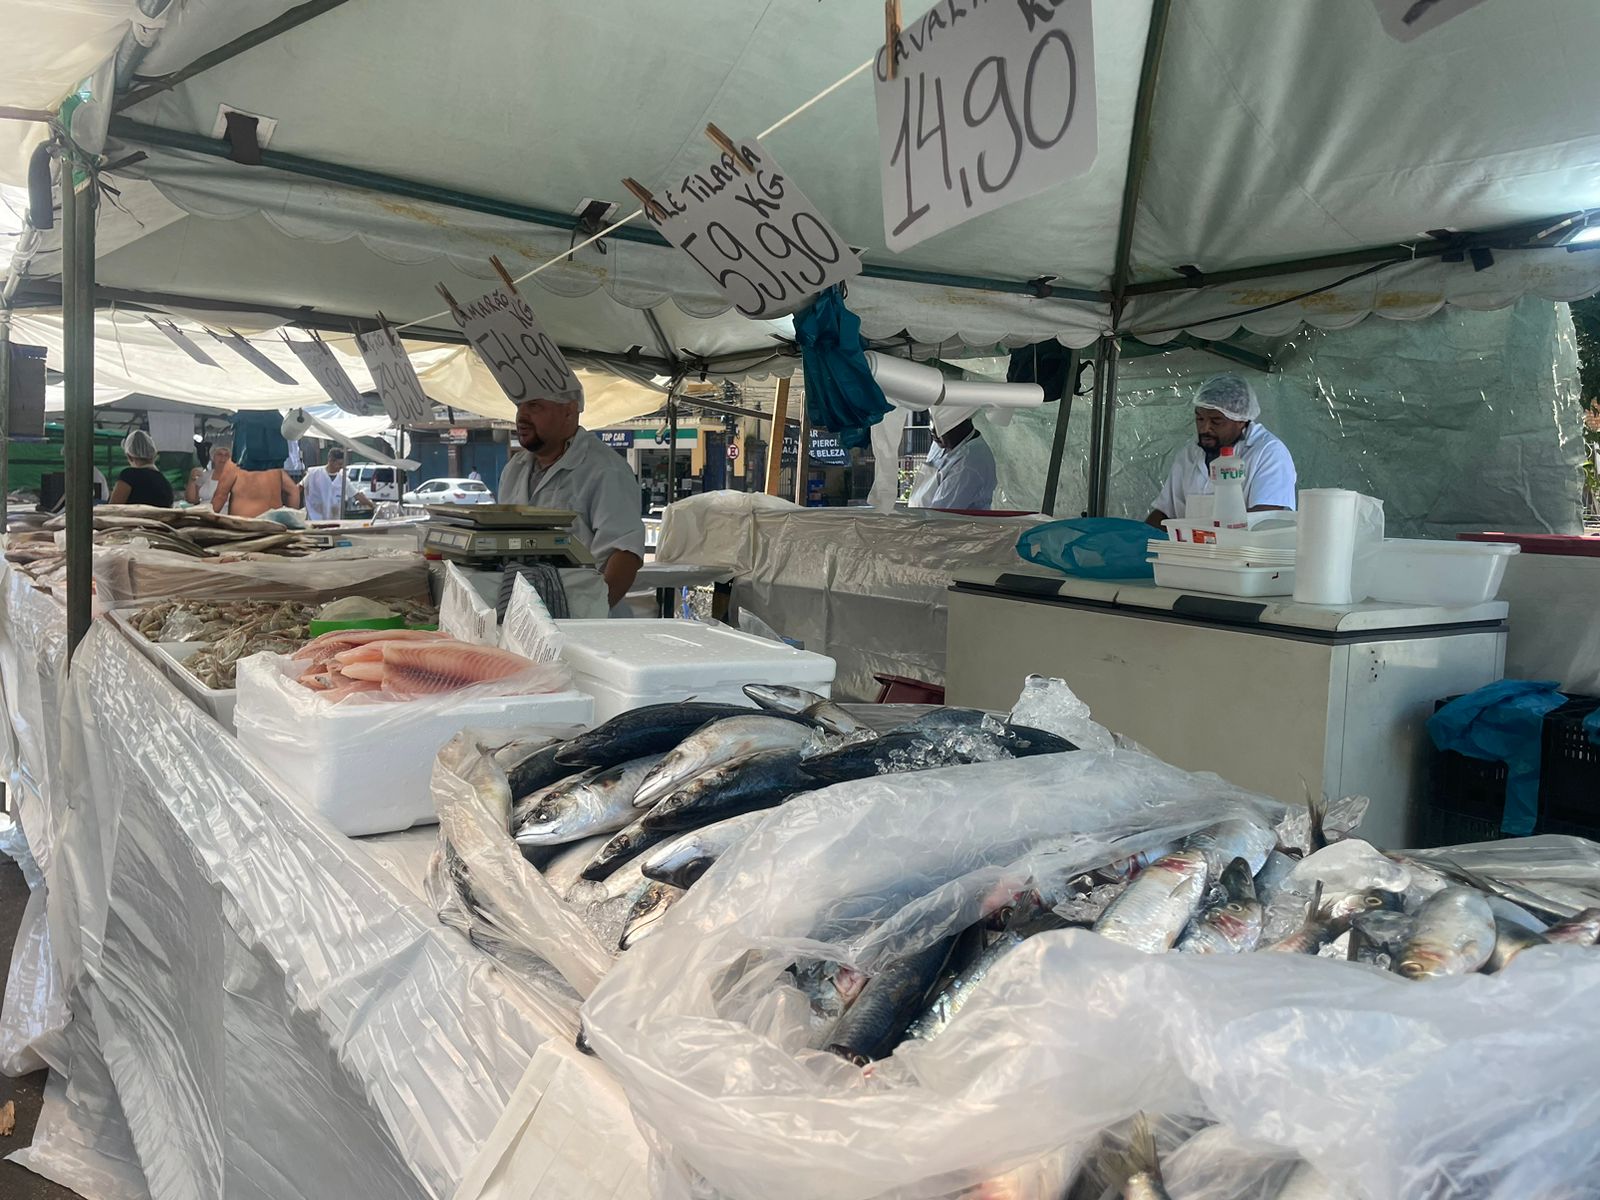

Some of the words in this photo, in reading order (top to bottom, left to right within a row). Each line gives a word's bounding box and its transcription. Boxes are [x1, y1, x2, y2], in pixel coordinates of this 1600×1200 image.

[890, 28, 1077, 237] 14,90
[735, 170, 784, 219] KG
[680, 212, 840, 316] 59,90
[509, 298, 534, 329] KG
[475, 328, 570, 400] 54,90
[601, 432, 612, 442] TOP
[613, 432, 625, 442] CAR
[812, 438, 840, 448] PIERCI
[816, 448, 846, 458] BELEZA
